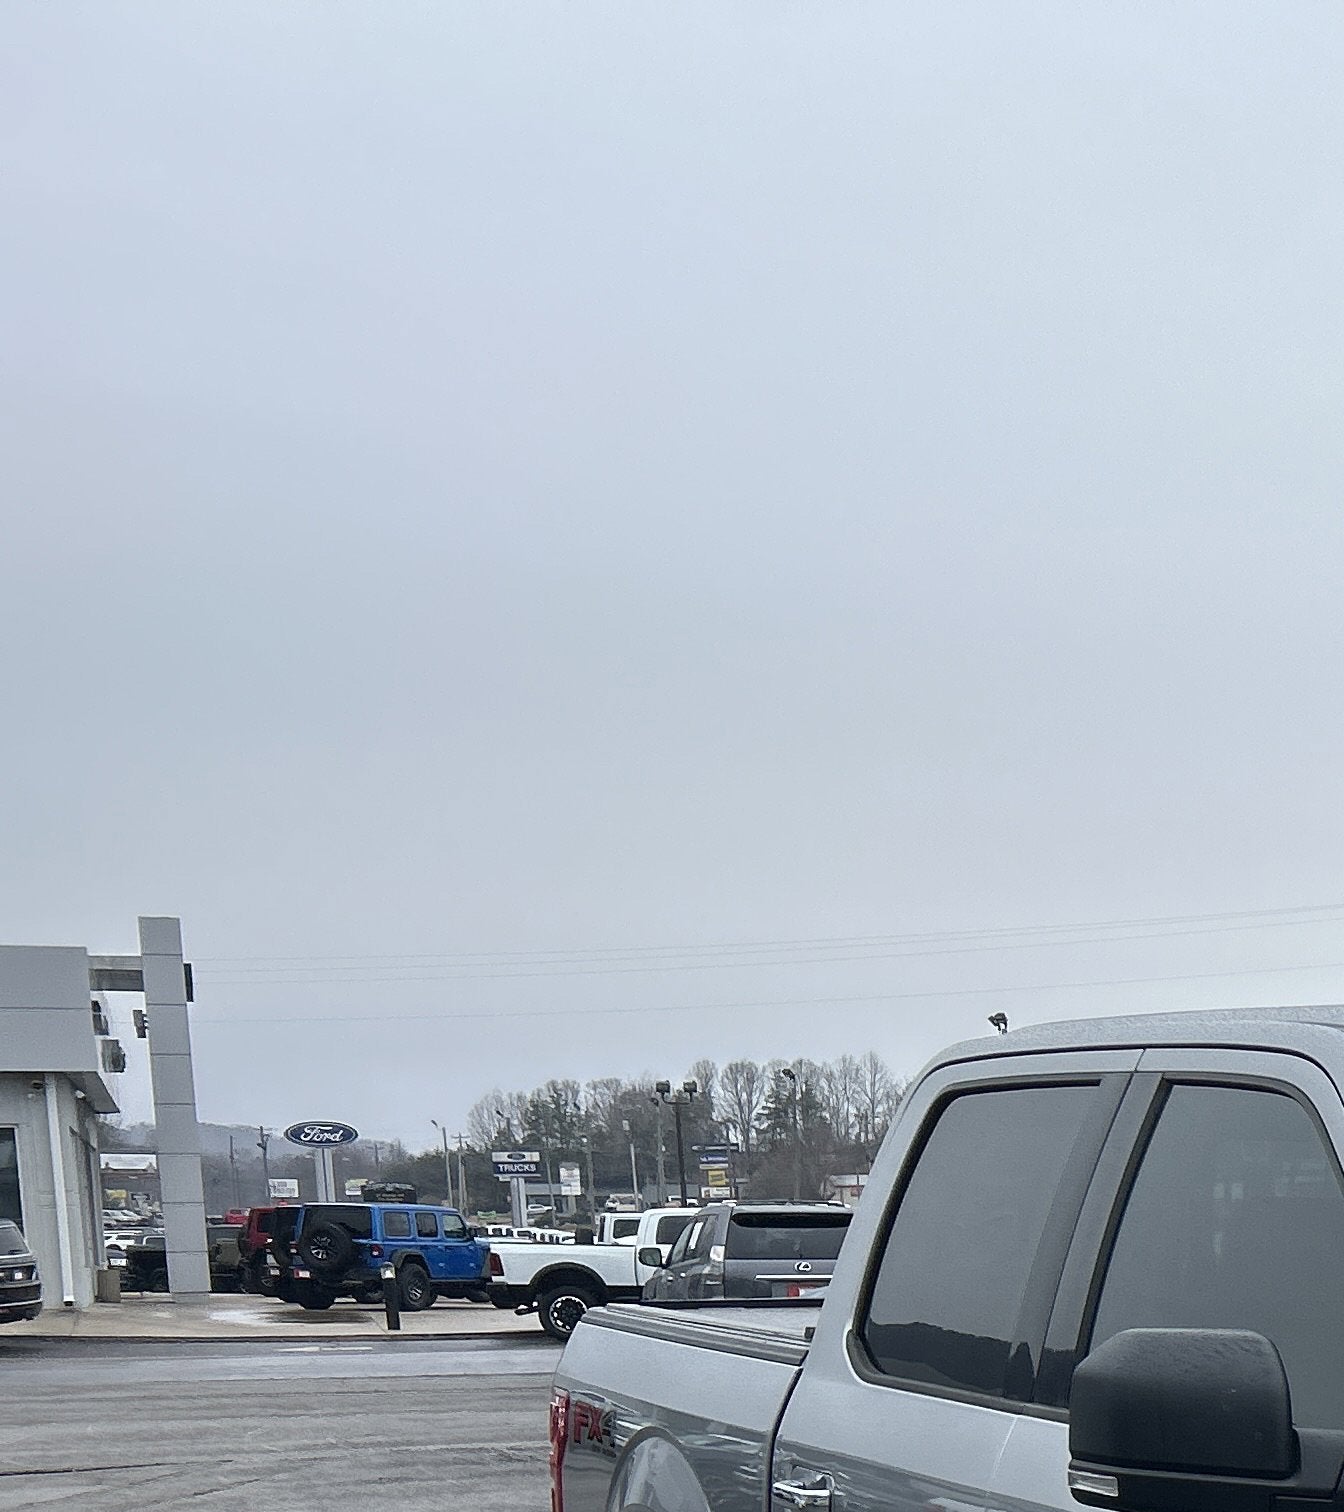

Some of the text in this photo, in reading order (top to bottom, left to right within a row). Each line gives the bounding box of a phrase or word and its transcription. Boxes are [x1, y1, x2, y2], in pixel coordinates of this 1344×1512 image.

[300, 1125, 344, 1142] Ford
[497, 1163, 537, 1172] TRUCKS
[573, 1400, 617, 1449] FX4
